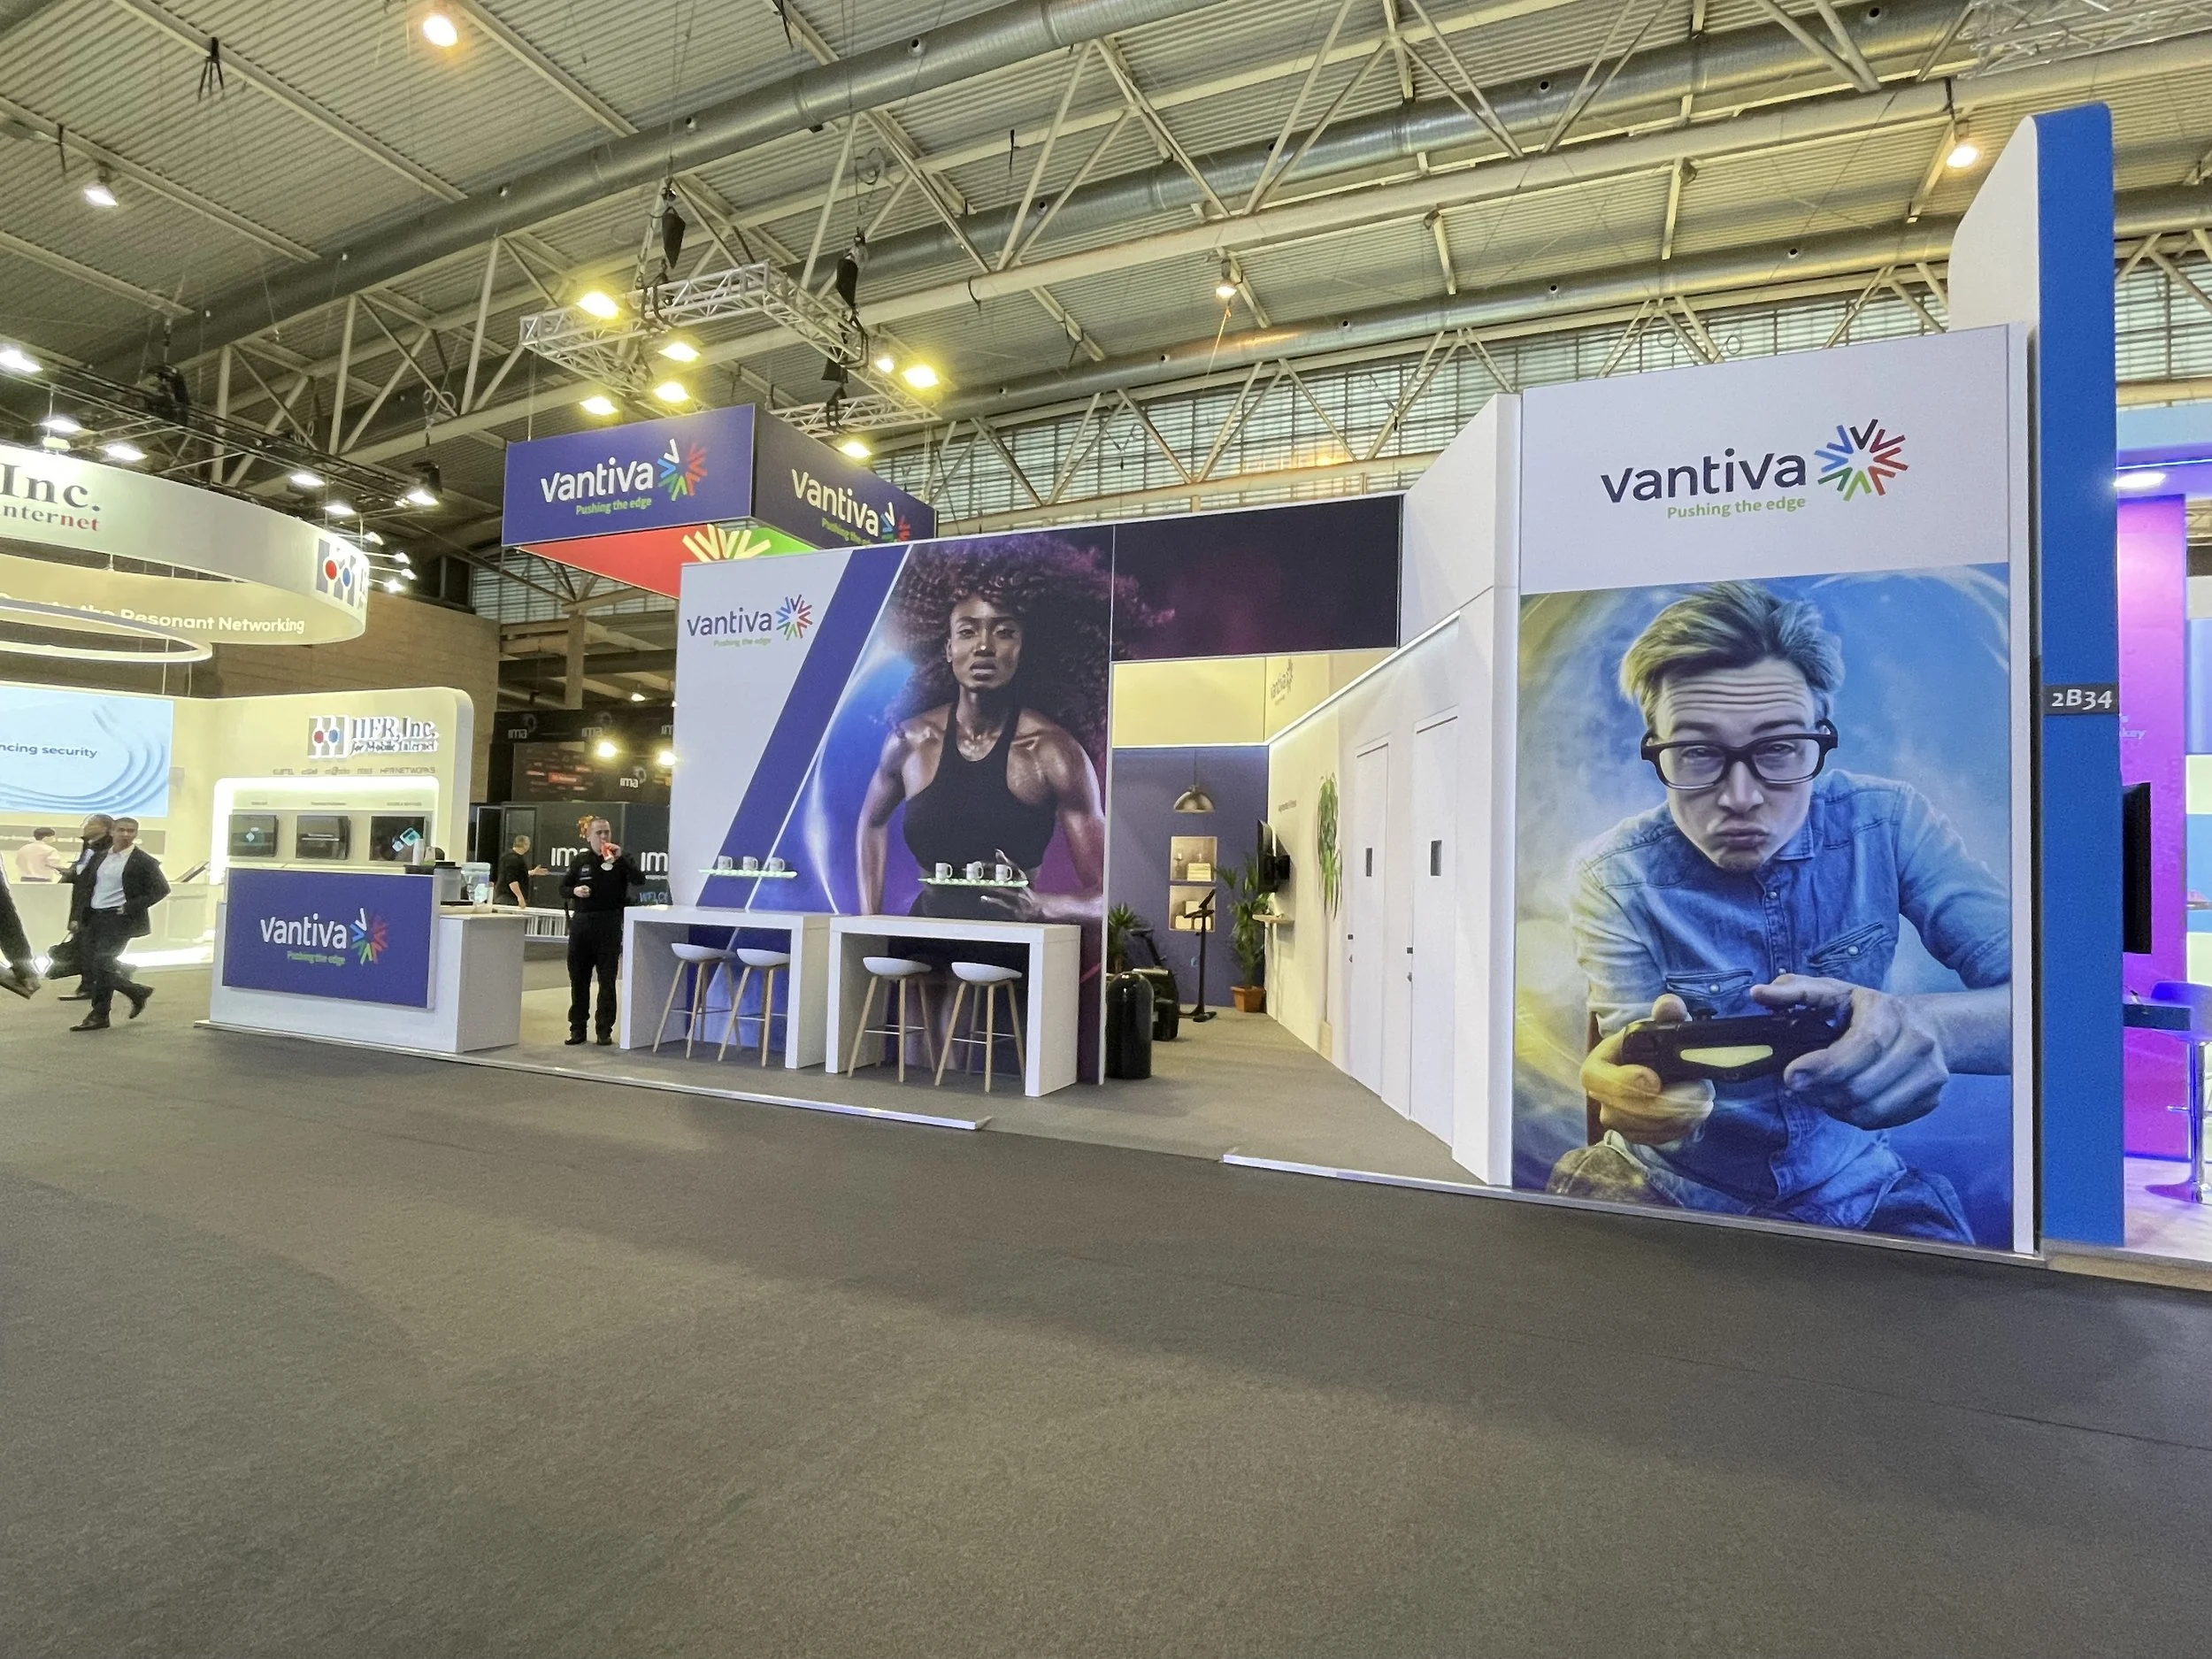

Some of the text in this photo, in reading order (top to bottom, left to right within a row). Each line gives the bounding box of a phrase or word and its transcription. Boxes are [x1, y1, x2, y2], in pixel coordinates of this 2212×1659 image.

[0, 463, 100, 509] Inc.
[541, 457, 654, 503] vantiva
[1601, 448, 1807, 503] vantiva
[576, 497, 652, 515] Pushing the edge
[791, 468, 879, 537] vantiva
[1668, 496, 1807, 518] Pushing the edge
[3, 505, 100, 532] nternet
[219, 618, 305, 634] Networking
[687, 607, 772, 636] vantiva
[2052, 689, 2113, 710] 2B34
[0, 742, 97, 758] ncing security
[641, 851, 668, 872] im
[260, 913, 347, 949] vantiva
